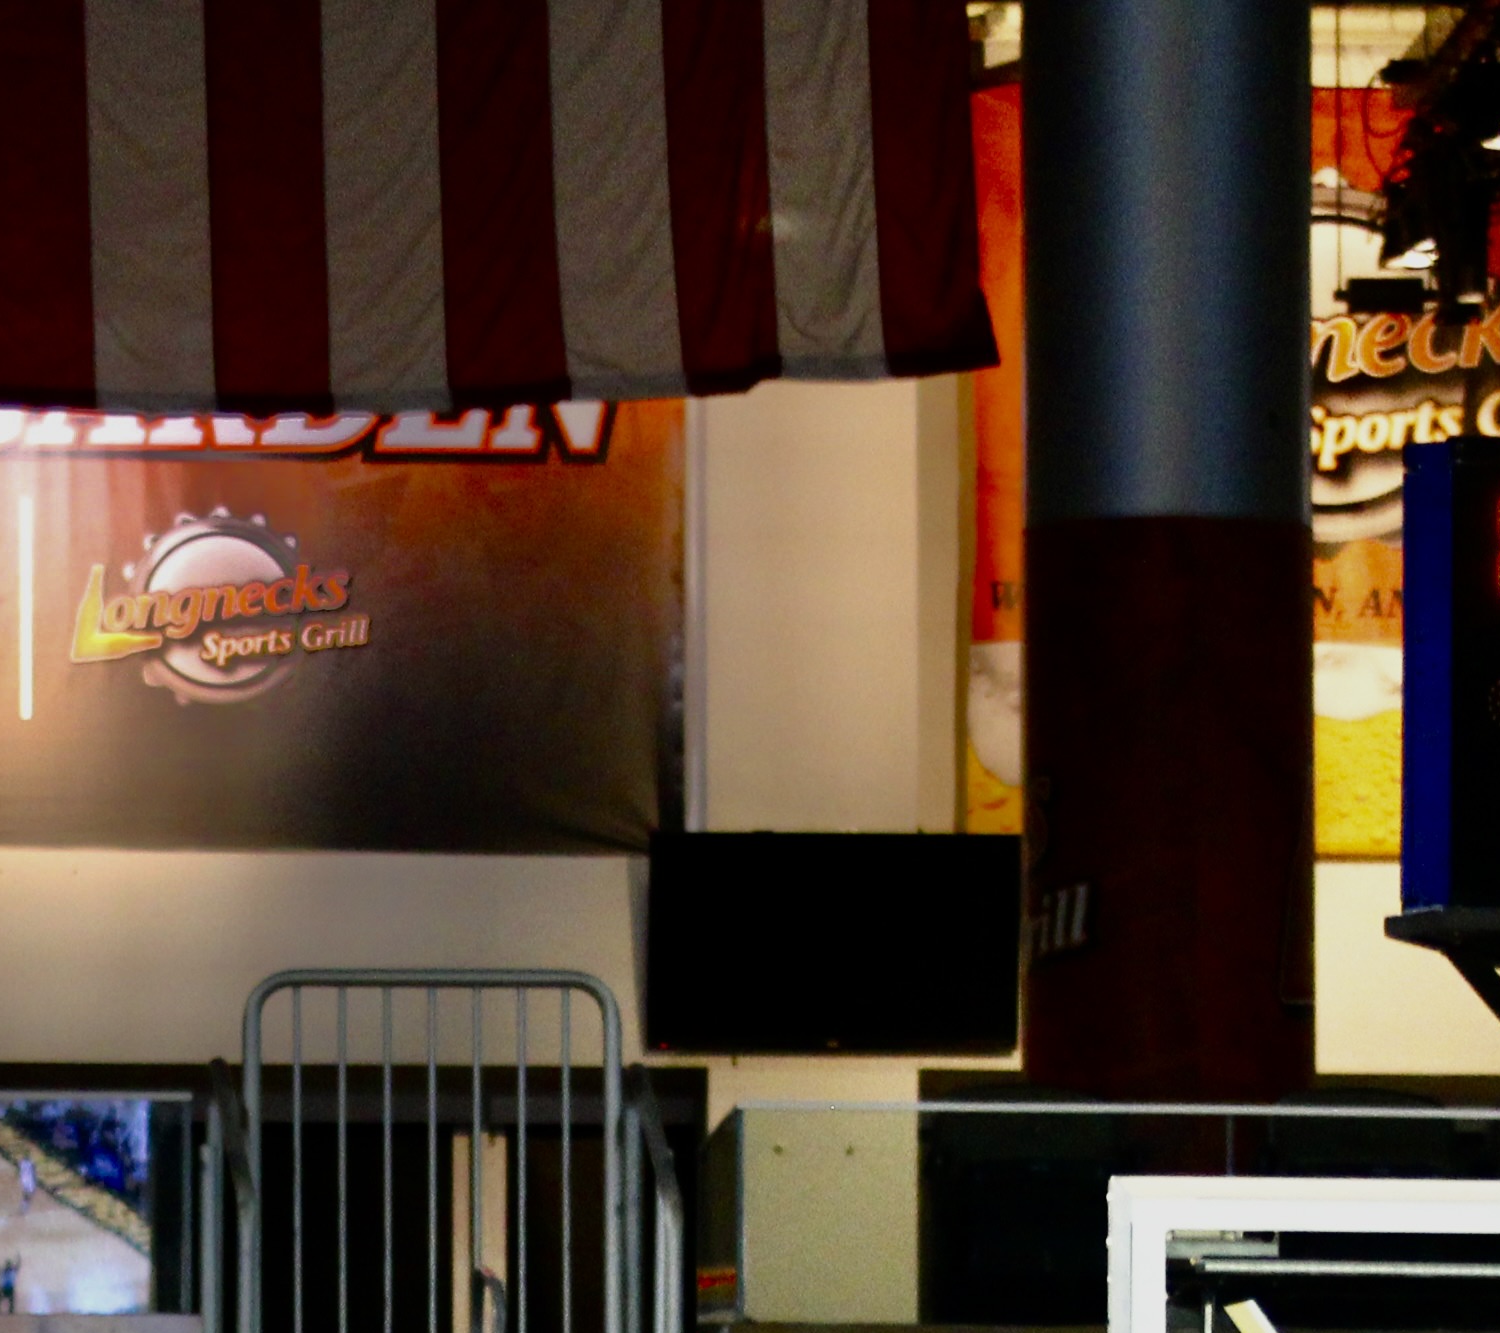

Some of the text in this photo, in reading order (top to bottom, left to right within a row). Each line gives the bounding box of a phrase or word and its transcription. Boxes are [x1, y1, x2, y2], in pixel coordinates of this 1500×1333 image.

[70, 564, 348, 664] Longnecks
[201, 615, 369, 667] Sports Grill
